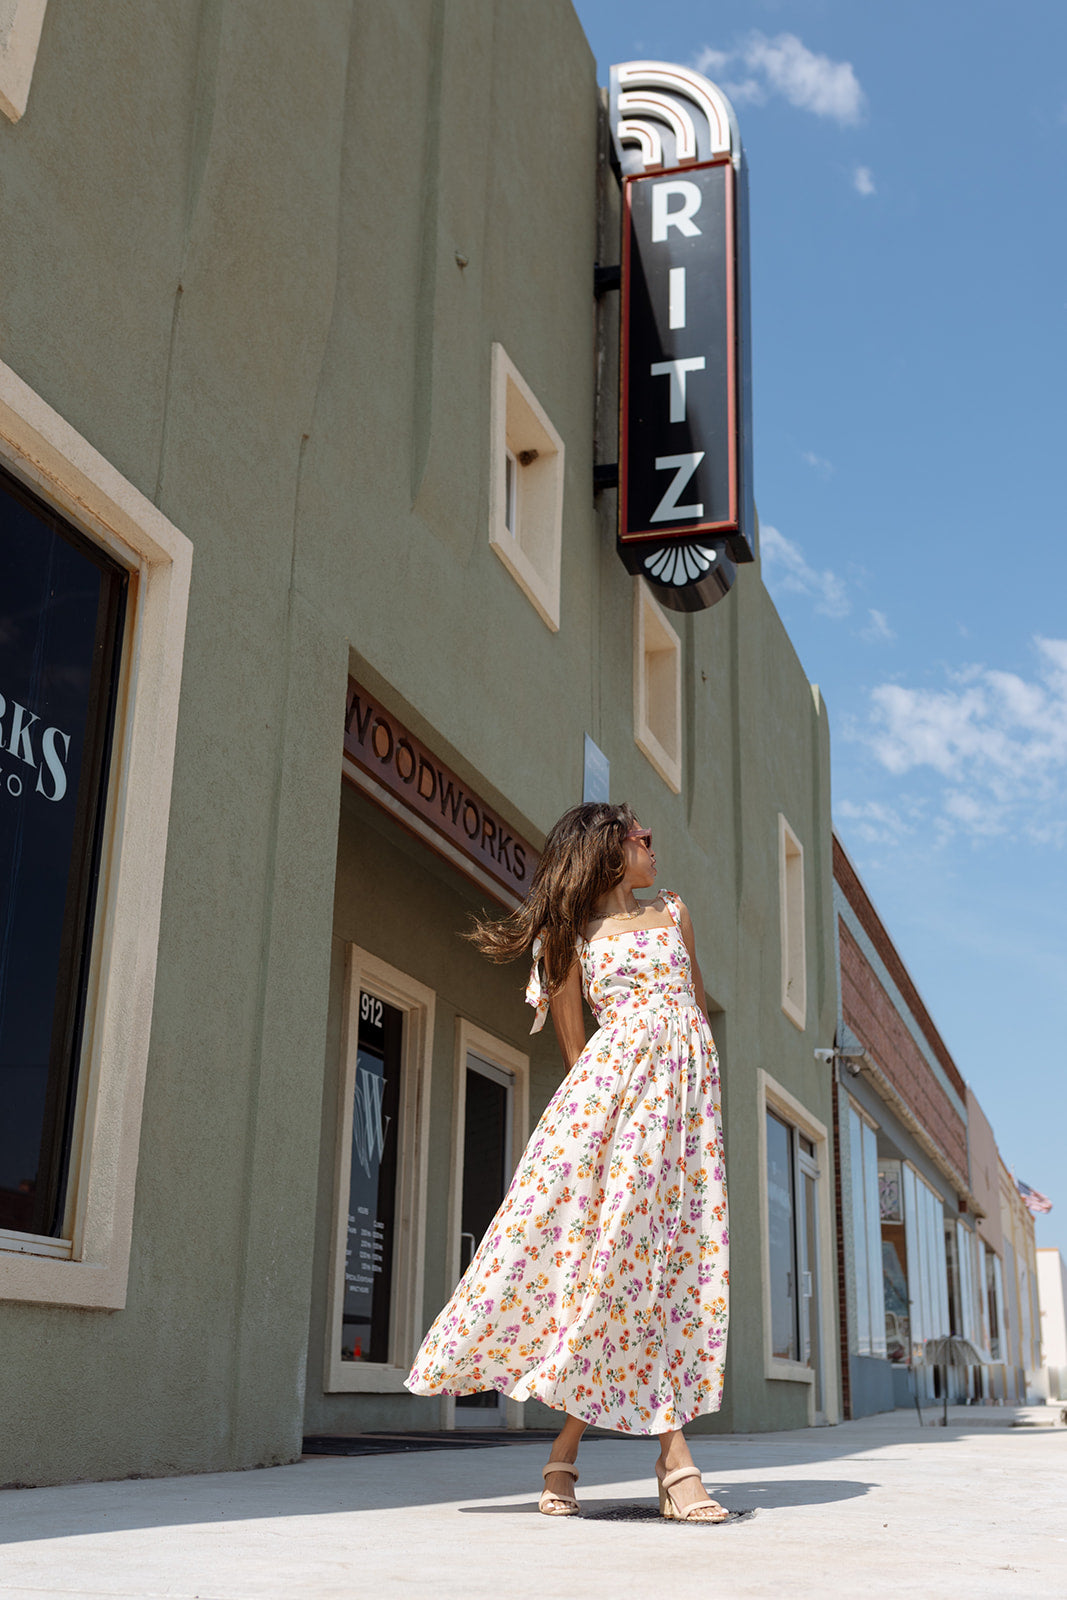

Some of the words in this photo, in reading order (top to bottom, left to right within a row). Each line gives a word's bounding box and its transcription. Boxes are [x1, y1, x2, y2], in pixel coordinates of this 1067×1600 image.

[649, 180, 706, 523] RITZ
[345, 693, 527, 882] WOODWORKS
[361, 993, 383, 1029] 912
